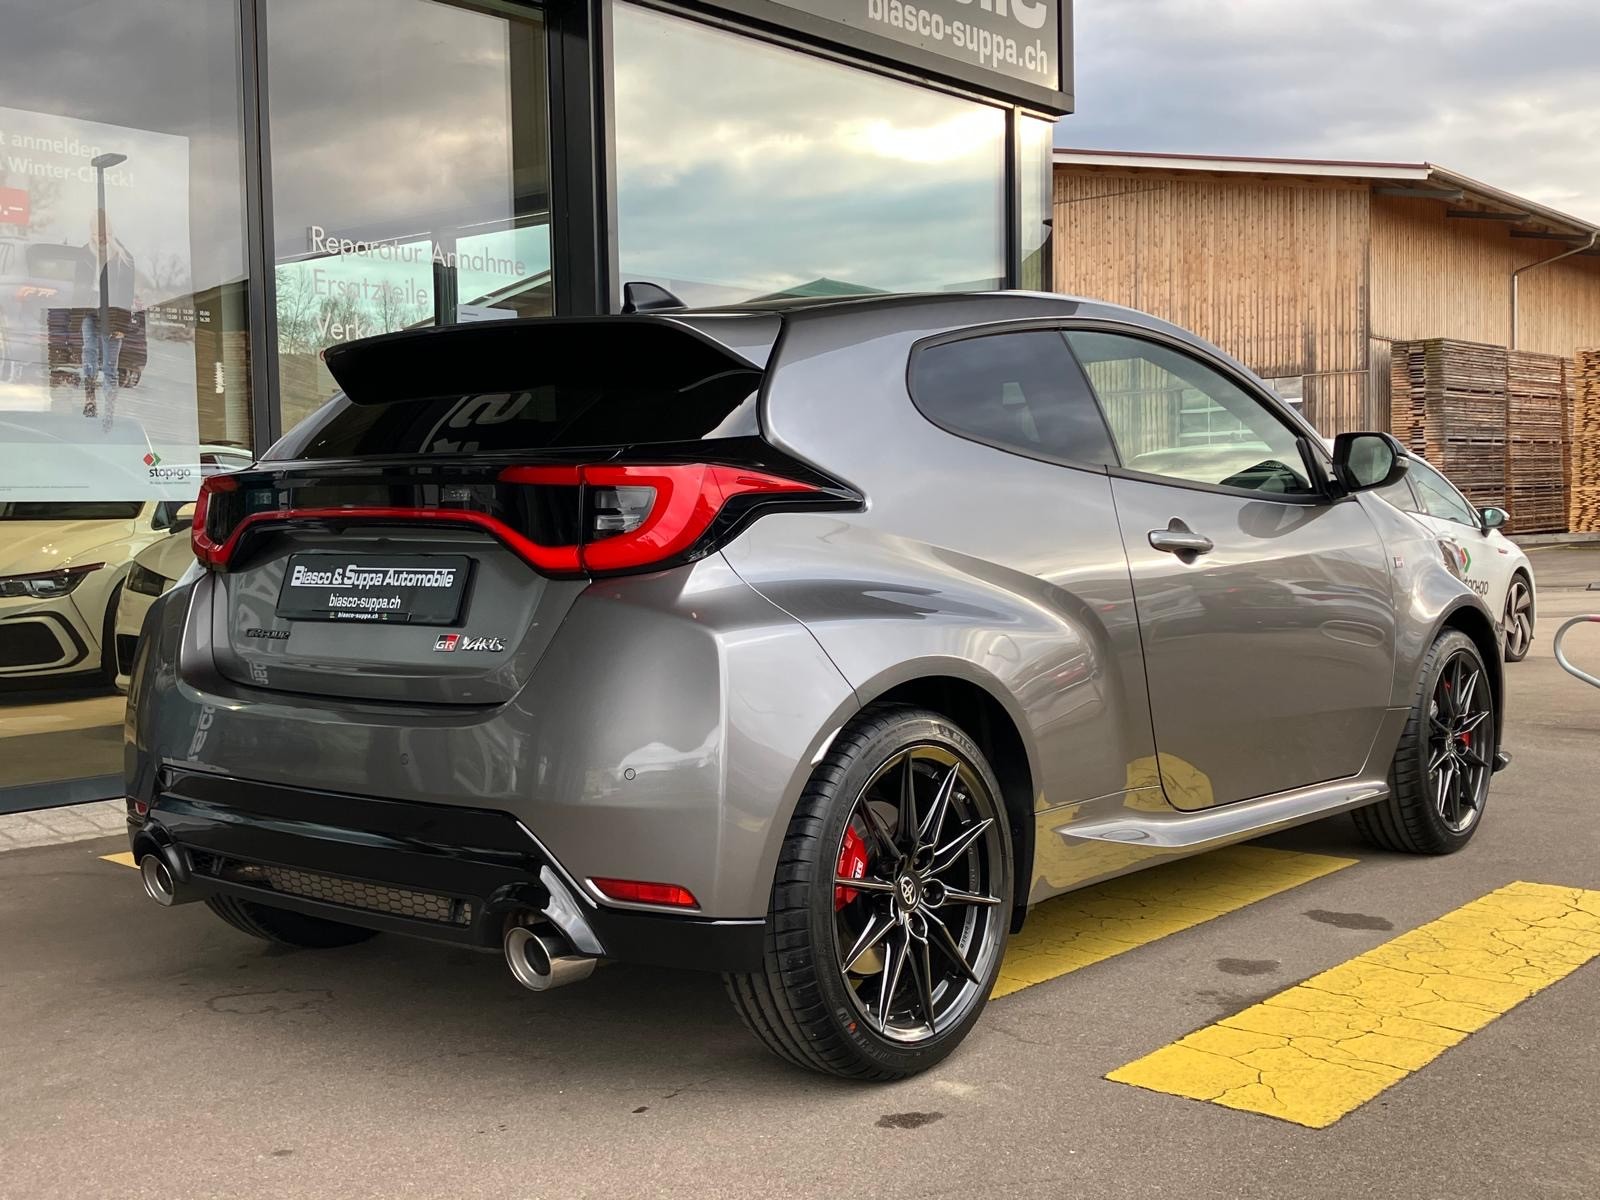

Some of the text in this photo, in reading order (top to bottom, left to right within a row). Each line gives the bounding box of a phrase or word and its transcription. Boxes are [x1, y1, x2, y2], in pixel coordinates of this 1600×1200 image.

[868, 0, 1047, 74] biasco-suppa.ch
[311, 225, 526, 276] Reparatur Annahme
[313, 269, 428, 305] Ersatzteile
[291, 565, 455, 589] Biasco & Suppa Automobile
[328, 593, 401, 612] biasco-suppa.ch
[435, 638, 457, 650] GR
